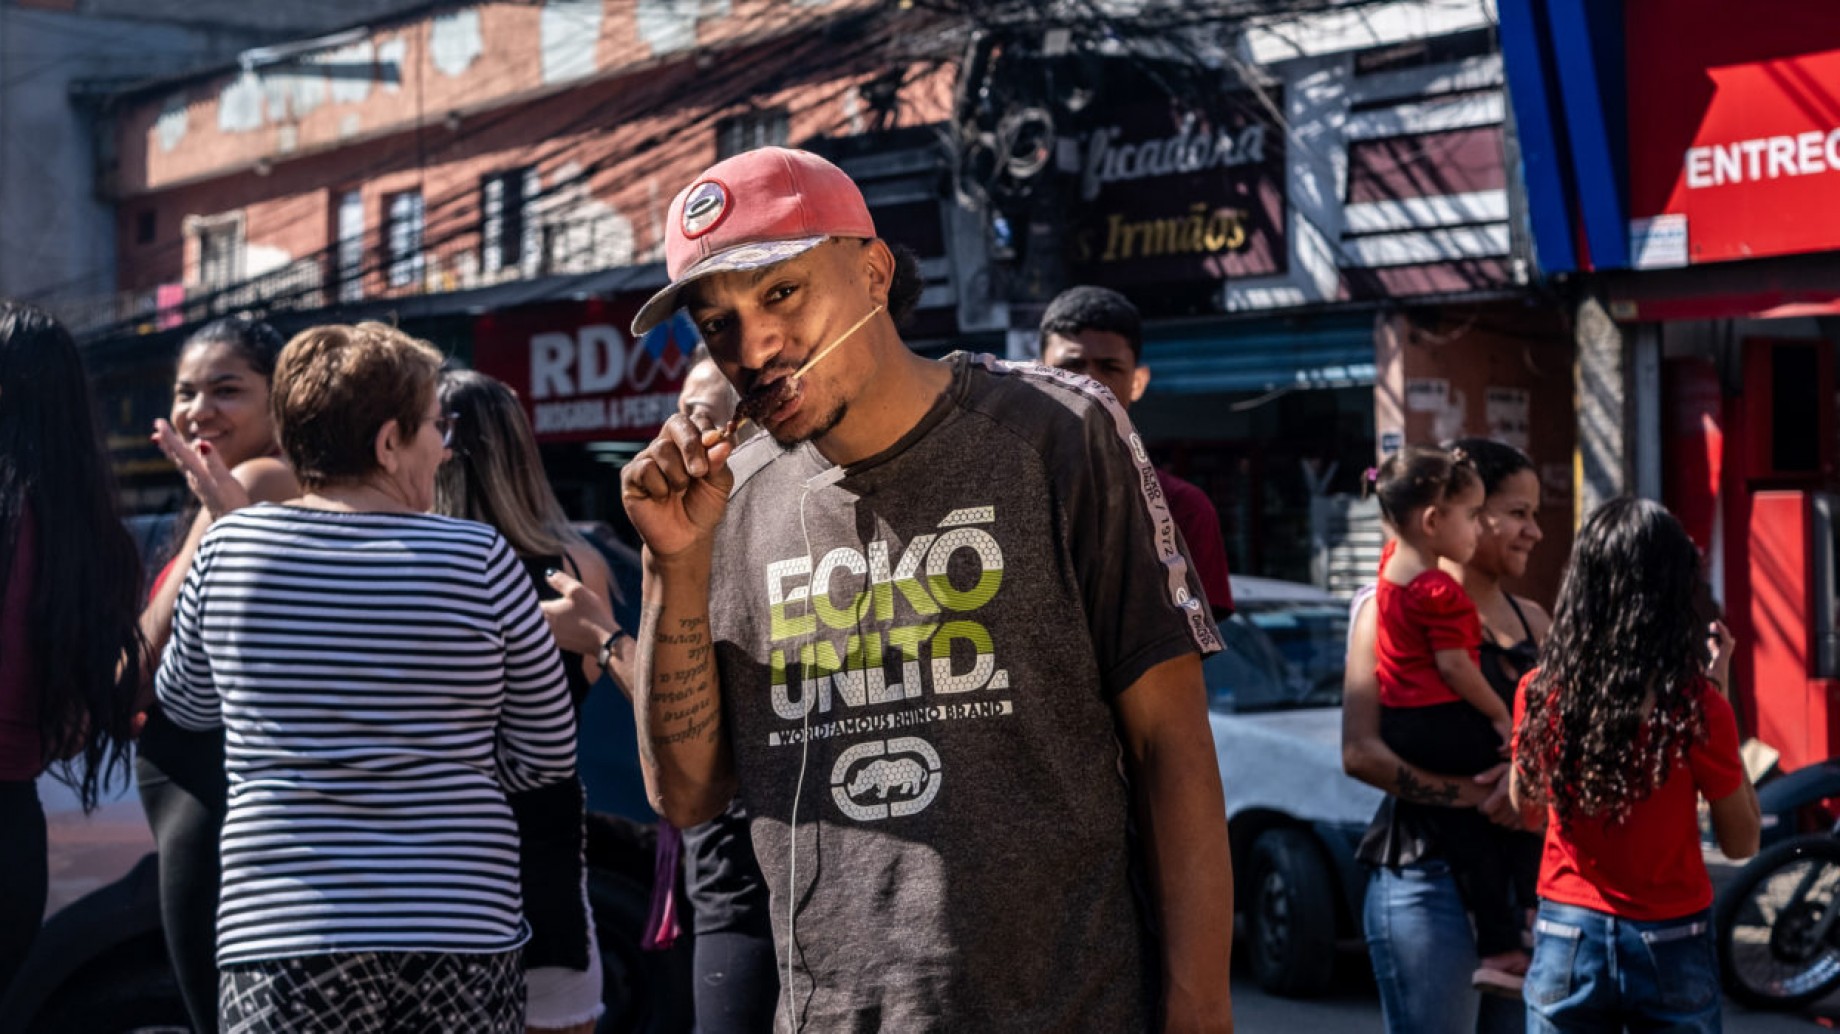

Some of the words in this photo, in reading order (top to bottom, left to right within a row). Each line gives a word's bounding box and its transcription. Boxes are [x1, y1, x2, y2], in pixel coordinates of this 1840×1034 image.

[1082, 113, 1265, 200] ficadora
[1103, 202, 1247, 260] Irmãos
[530, 325, 626, 398] RD
[1161, 517, 1174, 557] 1972
[771, 620, 1009, 720] UNLTD.
[896, 705, 940, 728] RHINO
[946, 700, 1004, 720] BRAND
